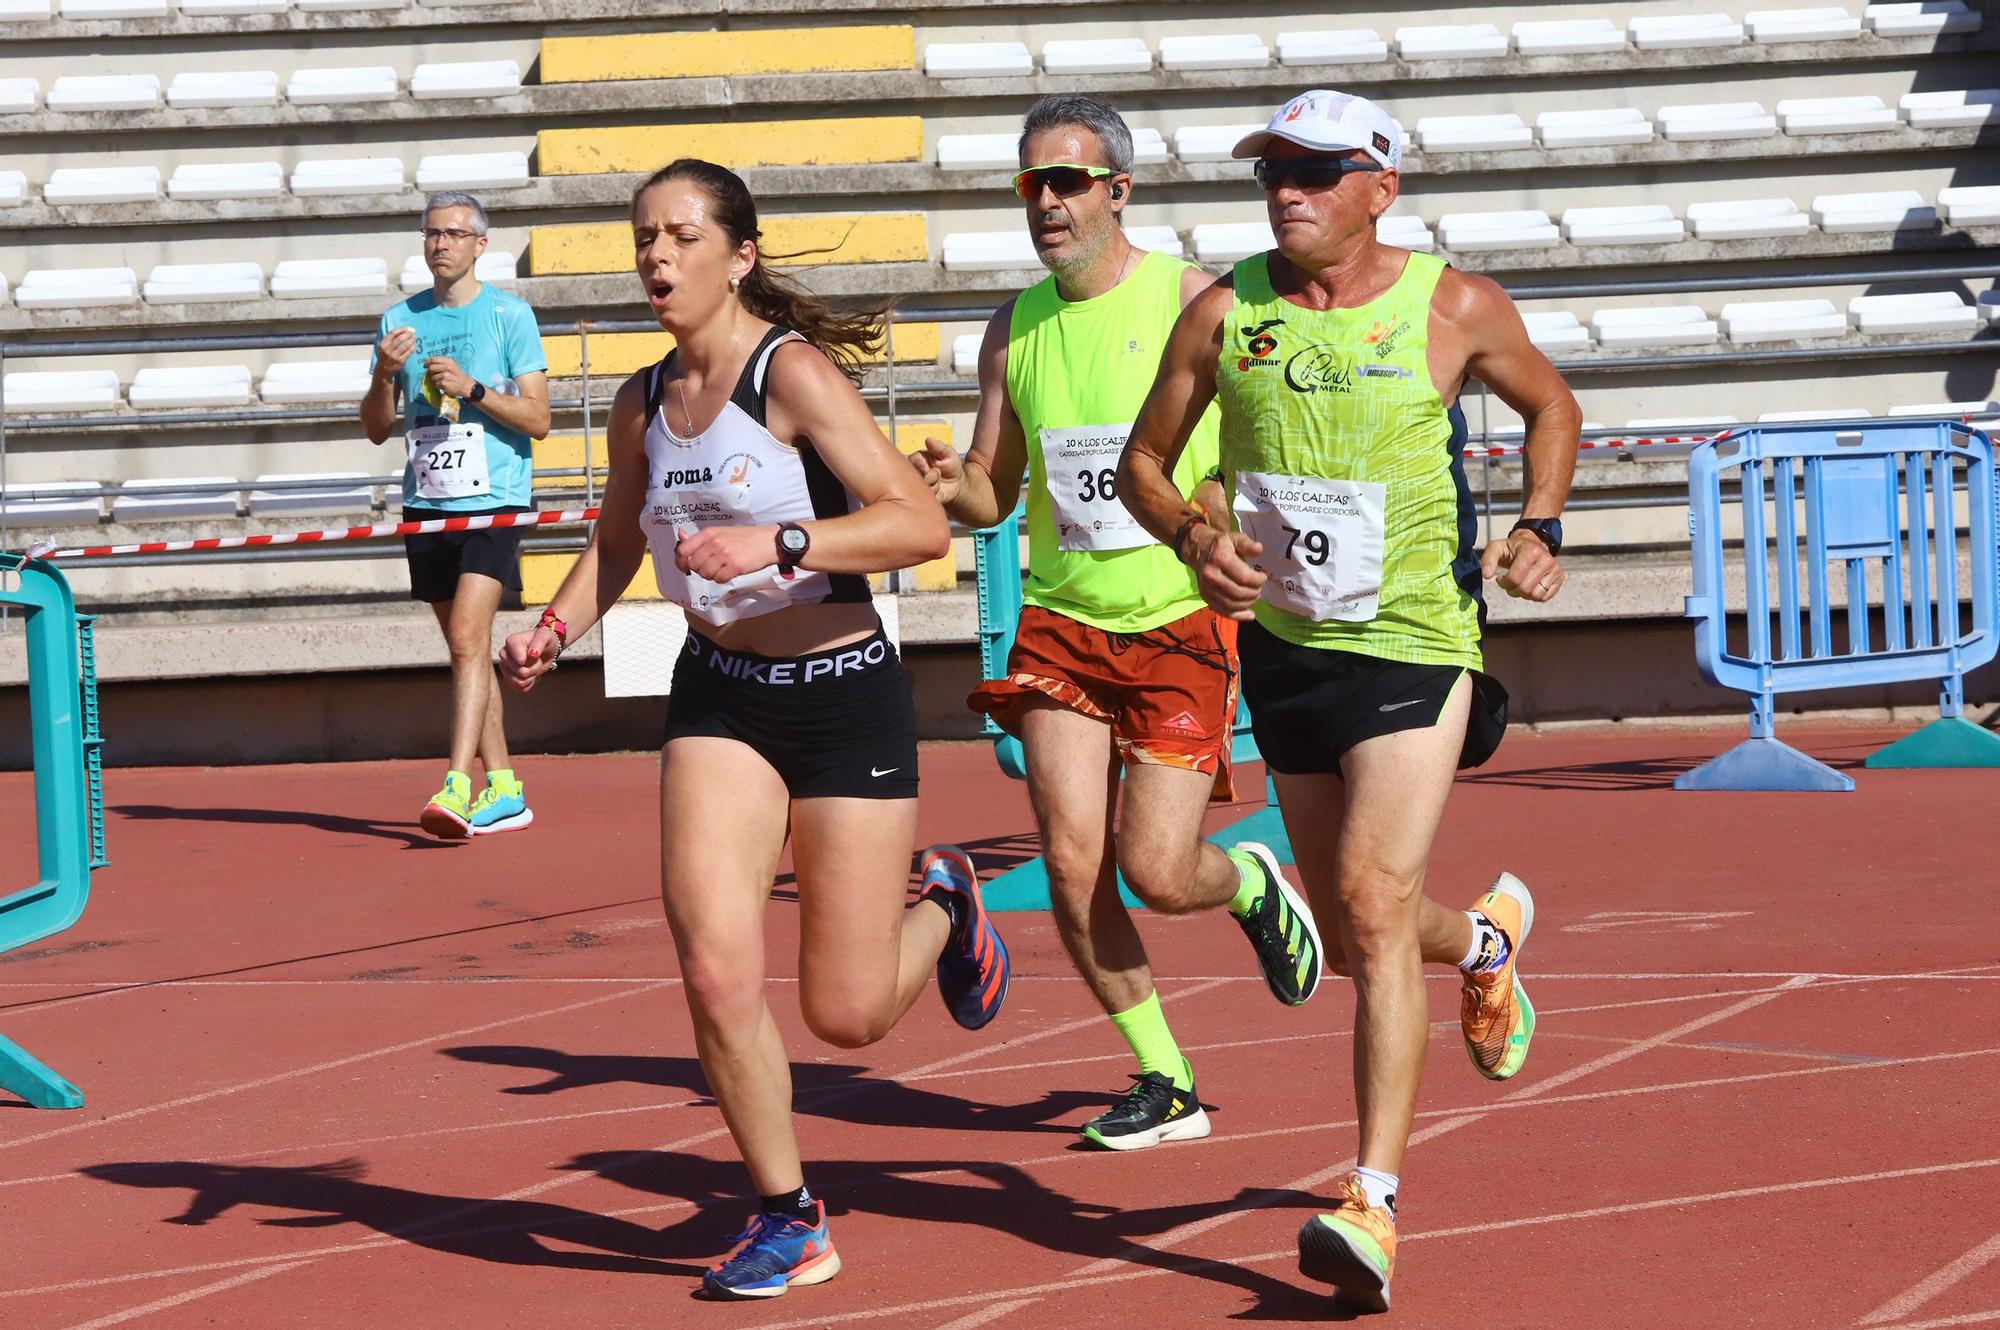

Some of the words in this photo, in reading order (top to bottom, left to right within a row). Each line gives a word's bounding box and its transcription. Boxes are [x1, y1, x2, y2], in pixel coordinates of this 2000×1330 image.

[1318, 385, 1352, 394] METAL
[1066, 439, 1076, 448] 10
[1077, 439, 1083, 448] K
[1085, 438, 1100, 447] LOS
[1101, 436, 1130, 446] CALIF
[428, 449, 466, 471] 227
[1077, 468, 1118, 502] 36
[1260, 487, 1269, 498] 10
[1270, 489, 1277, 500] K
[1280, 490, 1300, 502] LOS
[1302, 492, 1349, 506] CALIFAS
[654, 505, 663, 516] 10
[664, 506, 669, 516] K
[670, 504, 687, 515] LOS
[688, 502, 721, 512] CALIFAS
[1280, 503, 1321, 514] POPULARES
[1322, 507, 1361, 517] CORDOBA
[1281, 525, 1330, 566] 79
[709, 649, 797, 685] NIKE
[804, 640, 886, 684] PRO
